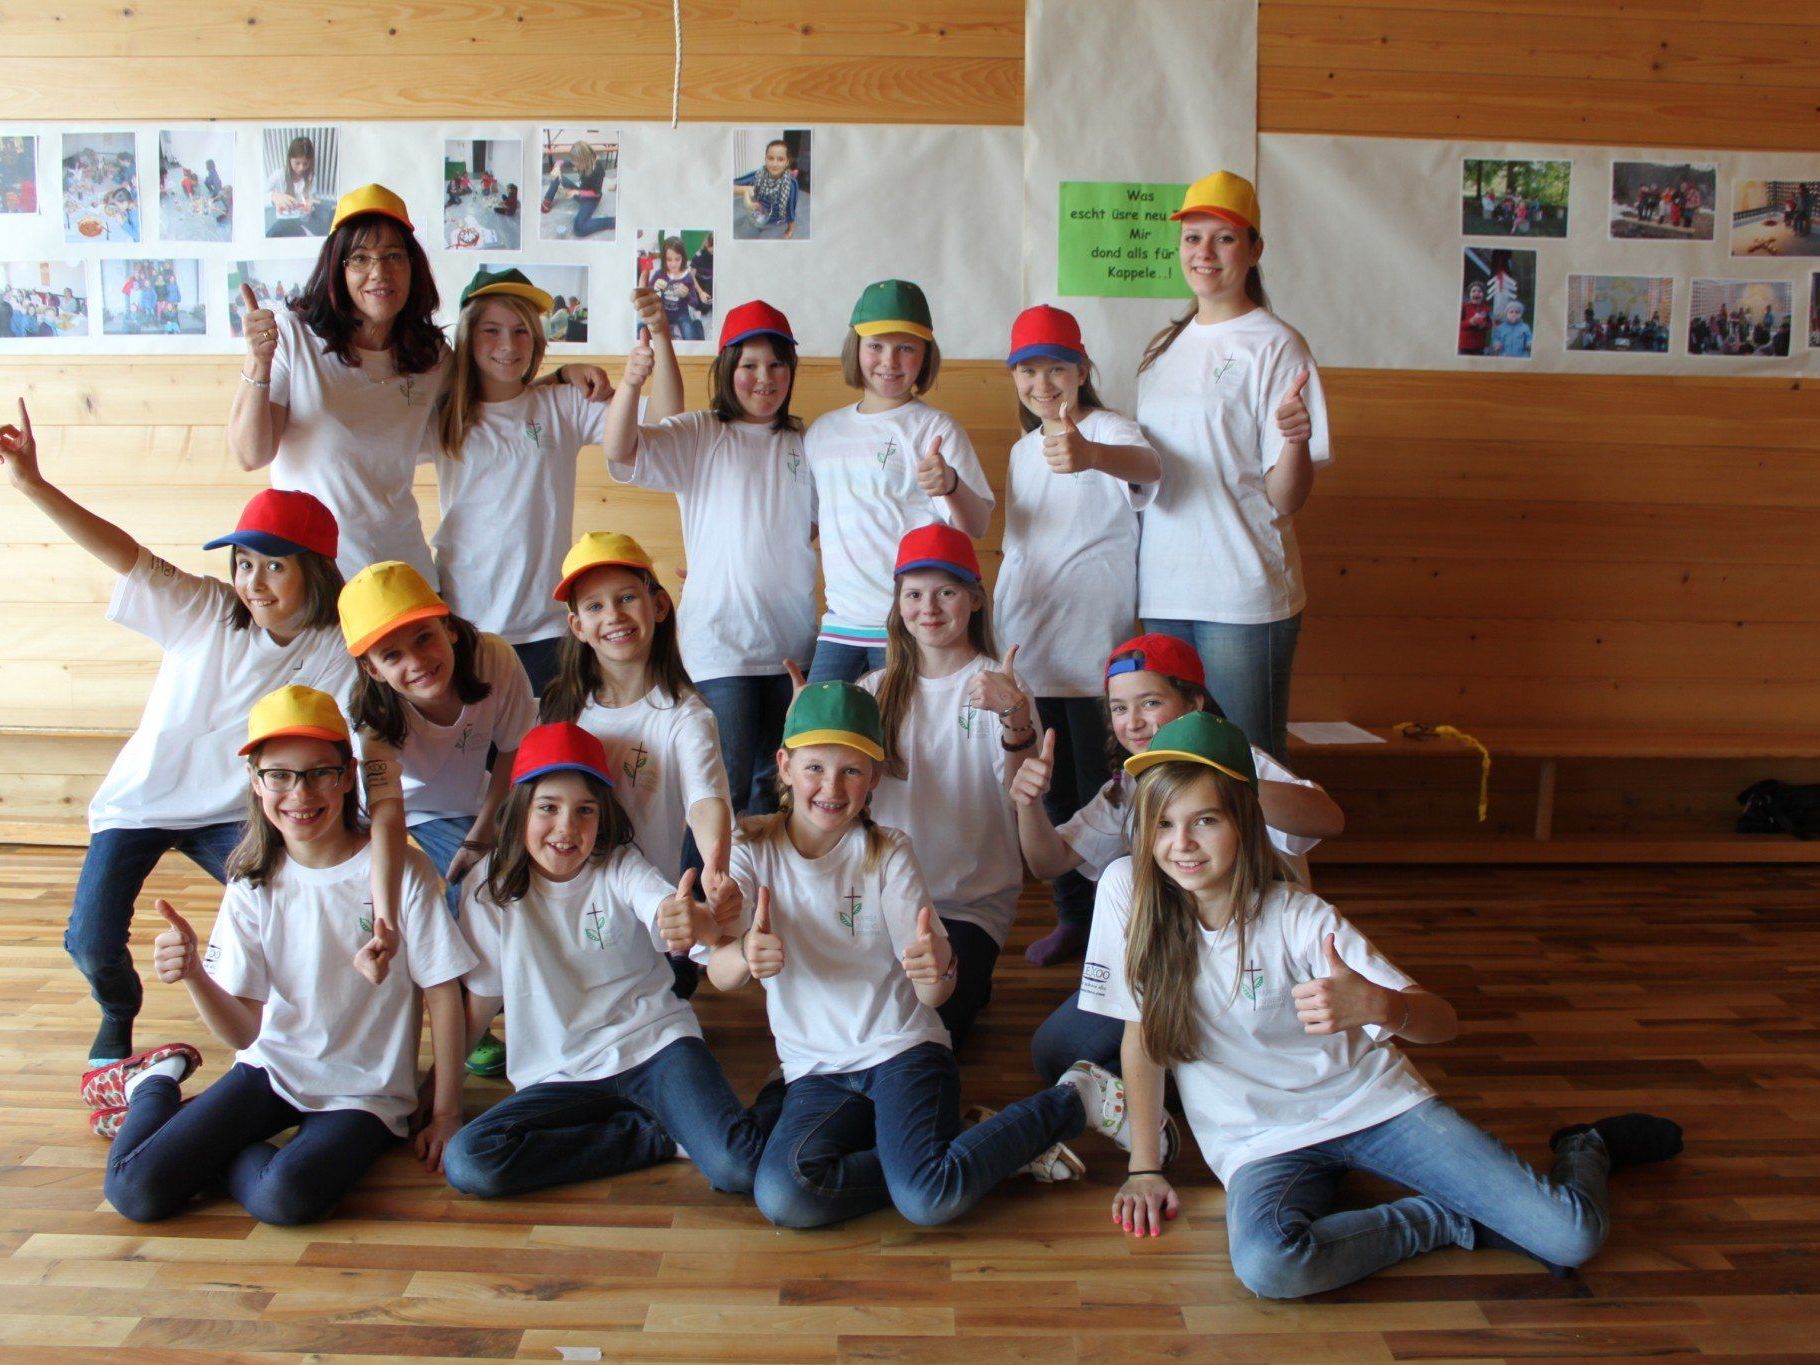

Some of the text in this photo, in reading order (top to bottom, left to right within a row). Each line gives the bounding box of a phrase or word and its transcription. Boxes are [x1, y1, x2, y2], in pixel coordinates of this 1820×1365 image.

[1126, 189, 1155, 202] Was
[1070, 208, 1105, 220] escht
[1129, 228, 1152, 240] Mir
[1091, 246, 1121, 259] dond
[1127, 246, 1148, 259] alls
